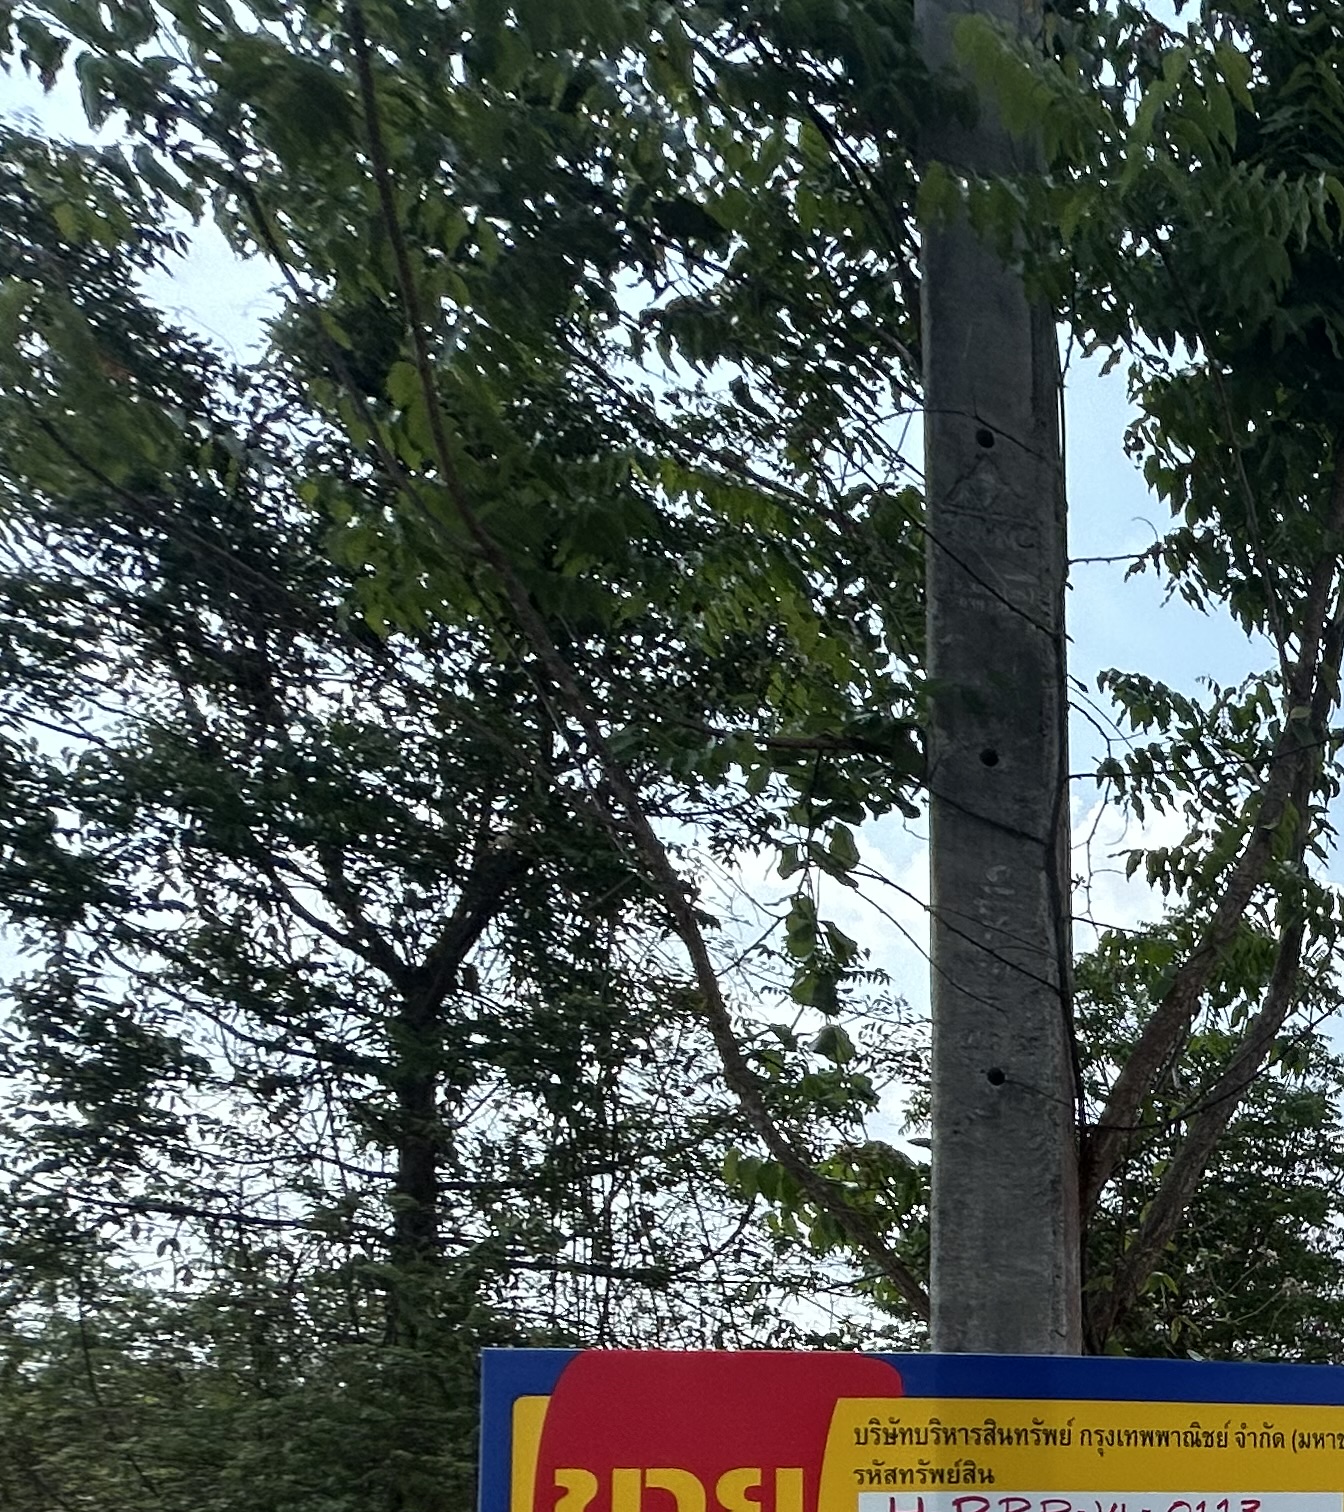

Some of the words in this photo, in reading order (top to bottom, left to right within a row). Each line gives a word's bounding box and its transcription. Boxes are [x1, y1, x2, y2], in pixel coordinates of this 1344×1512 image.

[854, 1417, 1075, 1446] บริษัทบริหารสินทรัพย์
[1080, 1418, 1232, 1457] กรุงเทพพาณิชย์
[1234, 1421, 1285, 1449] จำกัด
[853, 1459, 996, 1485] รหัสทรัพย์สิน
